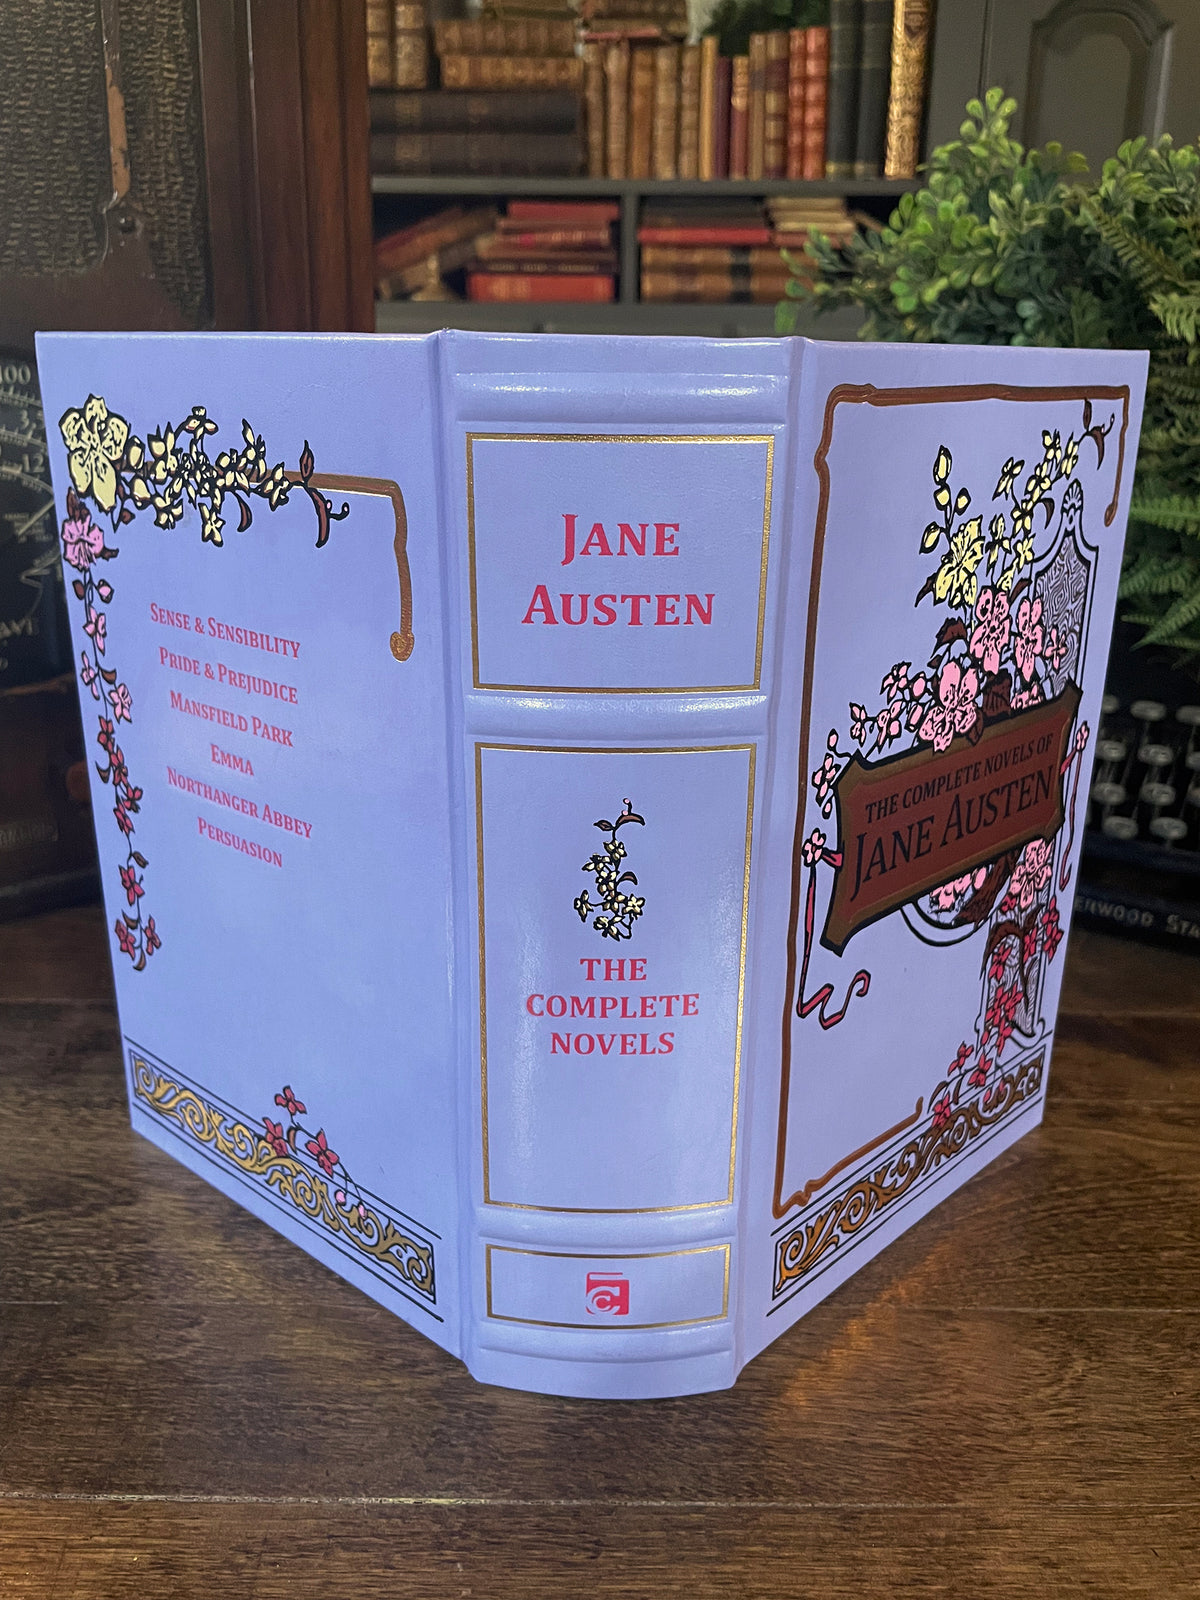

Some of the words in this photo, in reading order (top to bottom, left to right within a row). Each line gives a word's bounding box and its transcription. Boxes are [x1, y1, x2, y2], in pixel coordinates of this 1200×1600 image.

[561, 513, 680, 566] JANE
[150, 603, 191, 631] SENSE
[195, 616, 205, 634] &
[207, 617, 301, 659] SENSIBILITY
[521, 584, 715, 625] AUSTEN
[159, 646, 201, 676] PRIDE
[204, 662, 215, 680] &
[217, 663, 298, 705] PREJUDICE
[170, 689, 249, 733] MANSFIELD
[251, 715, 294, 748] PARK
[210, 743, 255, 776] EMMA
[865, 792, 899, 824] THE
[902, 761, 982, 809] COMPLETE
[984, 744, 1035, 776] NOVELS
[1036, 733, 1054, 756] OF
[166, 766, 259, 818] NORTHANGER
[262, 803, 312, 839] ABBEY
[197, 816, 283, 868] PERSUASION
[850, 815, 936, 902] JANE
[940, 764, 1055, 848] AUSTEN
[579, 958, 647, 981] THE
[526, 993, 700, 1019] COMPLETE
[550, 1032, 675, 1056] NOVELS
